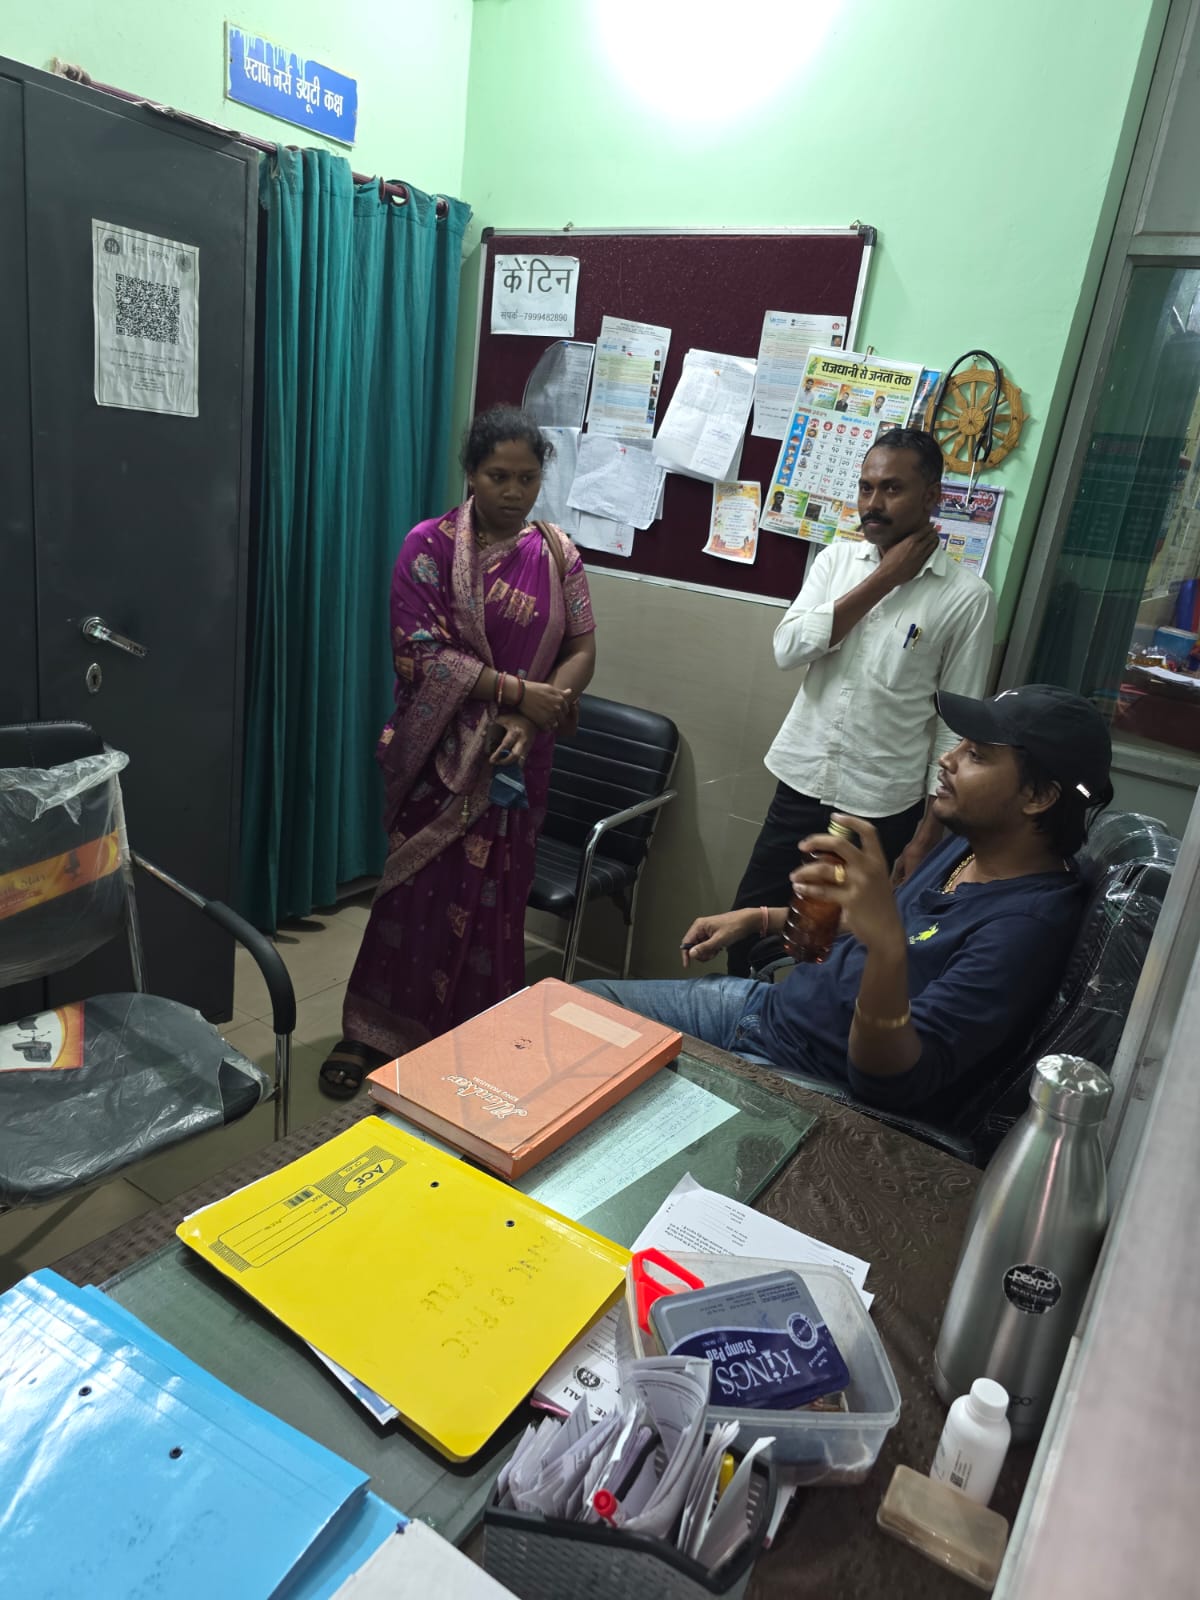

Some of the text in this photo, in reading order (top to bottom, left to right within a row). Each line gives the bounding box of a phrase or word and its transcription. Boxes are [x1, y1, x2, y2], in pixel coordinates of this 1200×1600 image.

[245, 57, 344, 118] स्टाफ नर्स ड्यूटी कक्ष
[822, 361, 912, 386] राजधानी से जनता तक
[353, 1164, 384, 1186] ACE
[1008, 1269, 1054, 1291] pexpo
[706, 1348, 727, 1363] Pad
[727, 1339, 756, 1356] Stamp
